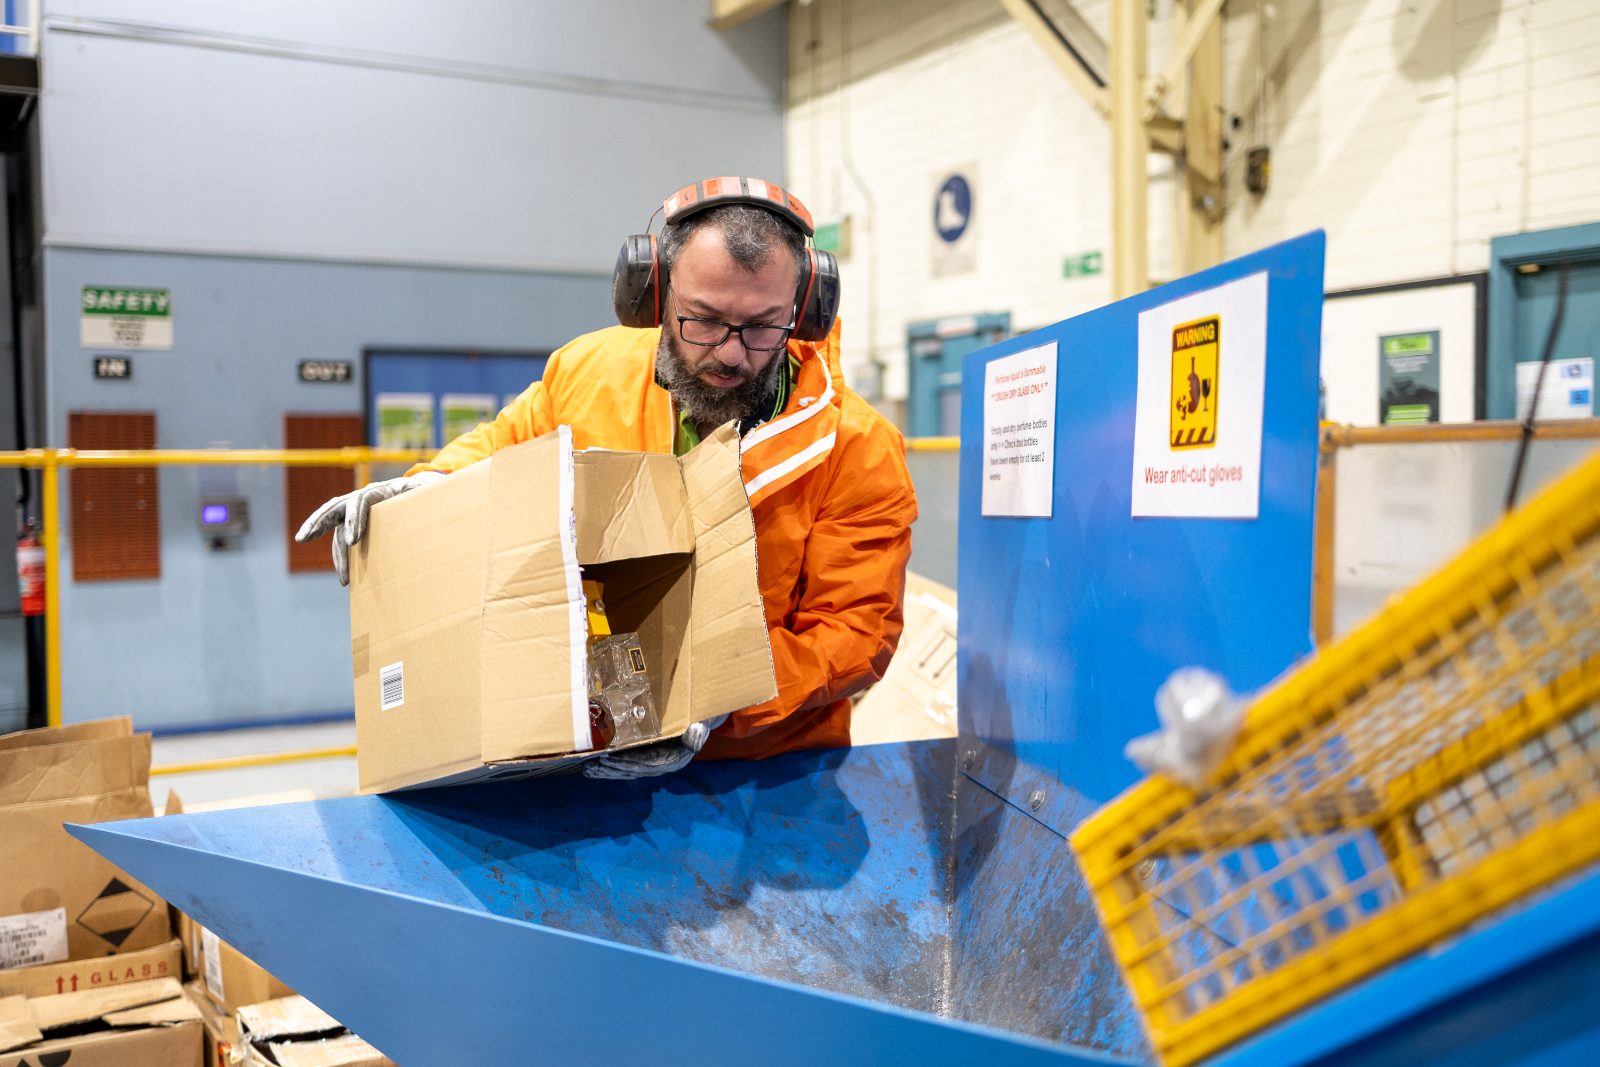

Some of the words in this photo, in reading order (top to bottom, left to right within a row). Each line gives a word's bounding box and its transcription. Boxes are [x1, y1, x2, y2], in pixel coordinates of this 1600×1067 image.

[84, 290, 168, 312] SAFETY
[1176, 323, 1215, 348] WARNING
[98, 358, 126, 377] IN
[302, 361, 347, 381] OUT
[1017, 385, 1030, 398] GLASS
[1030, 383, 1043, 395] ONLY
[1032, 418, 1047, 430] bottles
[1023, 437, 1038, 447] bottles
[1145, 467, 1168, 484] Wear
[1170, 464, 1206, 484] anti-cut
[1209, 463, 1243, 487] gloves
[91, 961, 168, 985] GLASS
